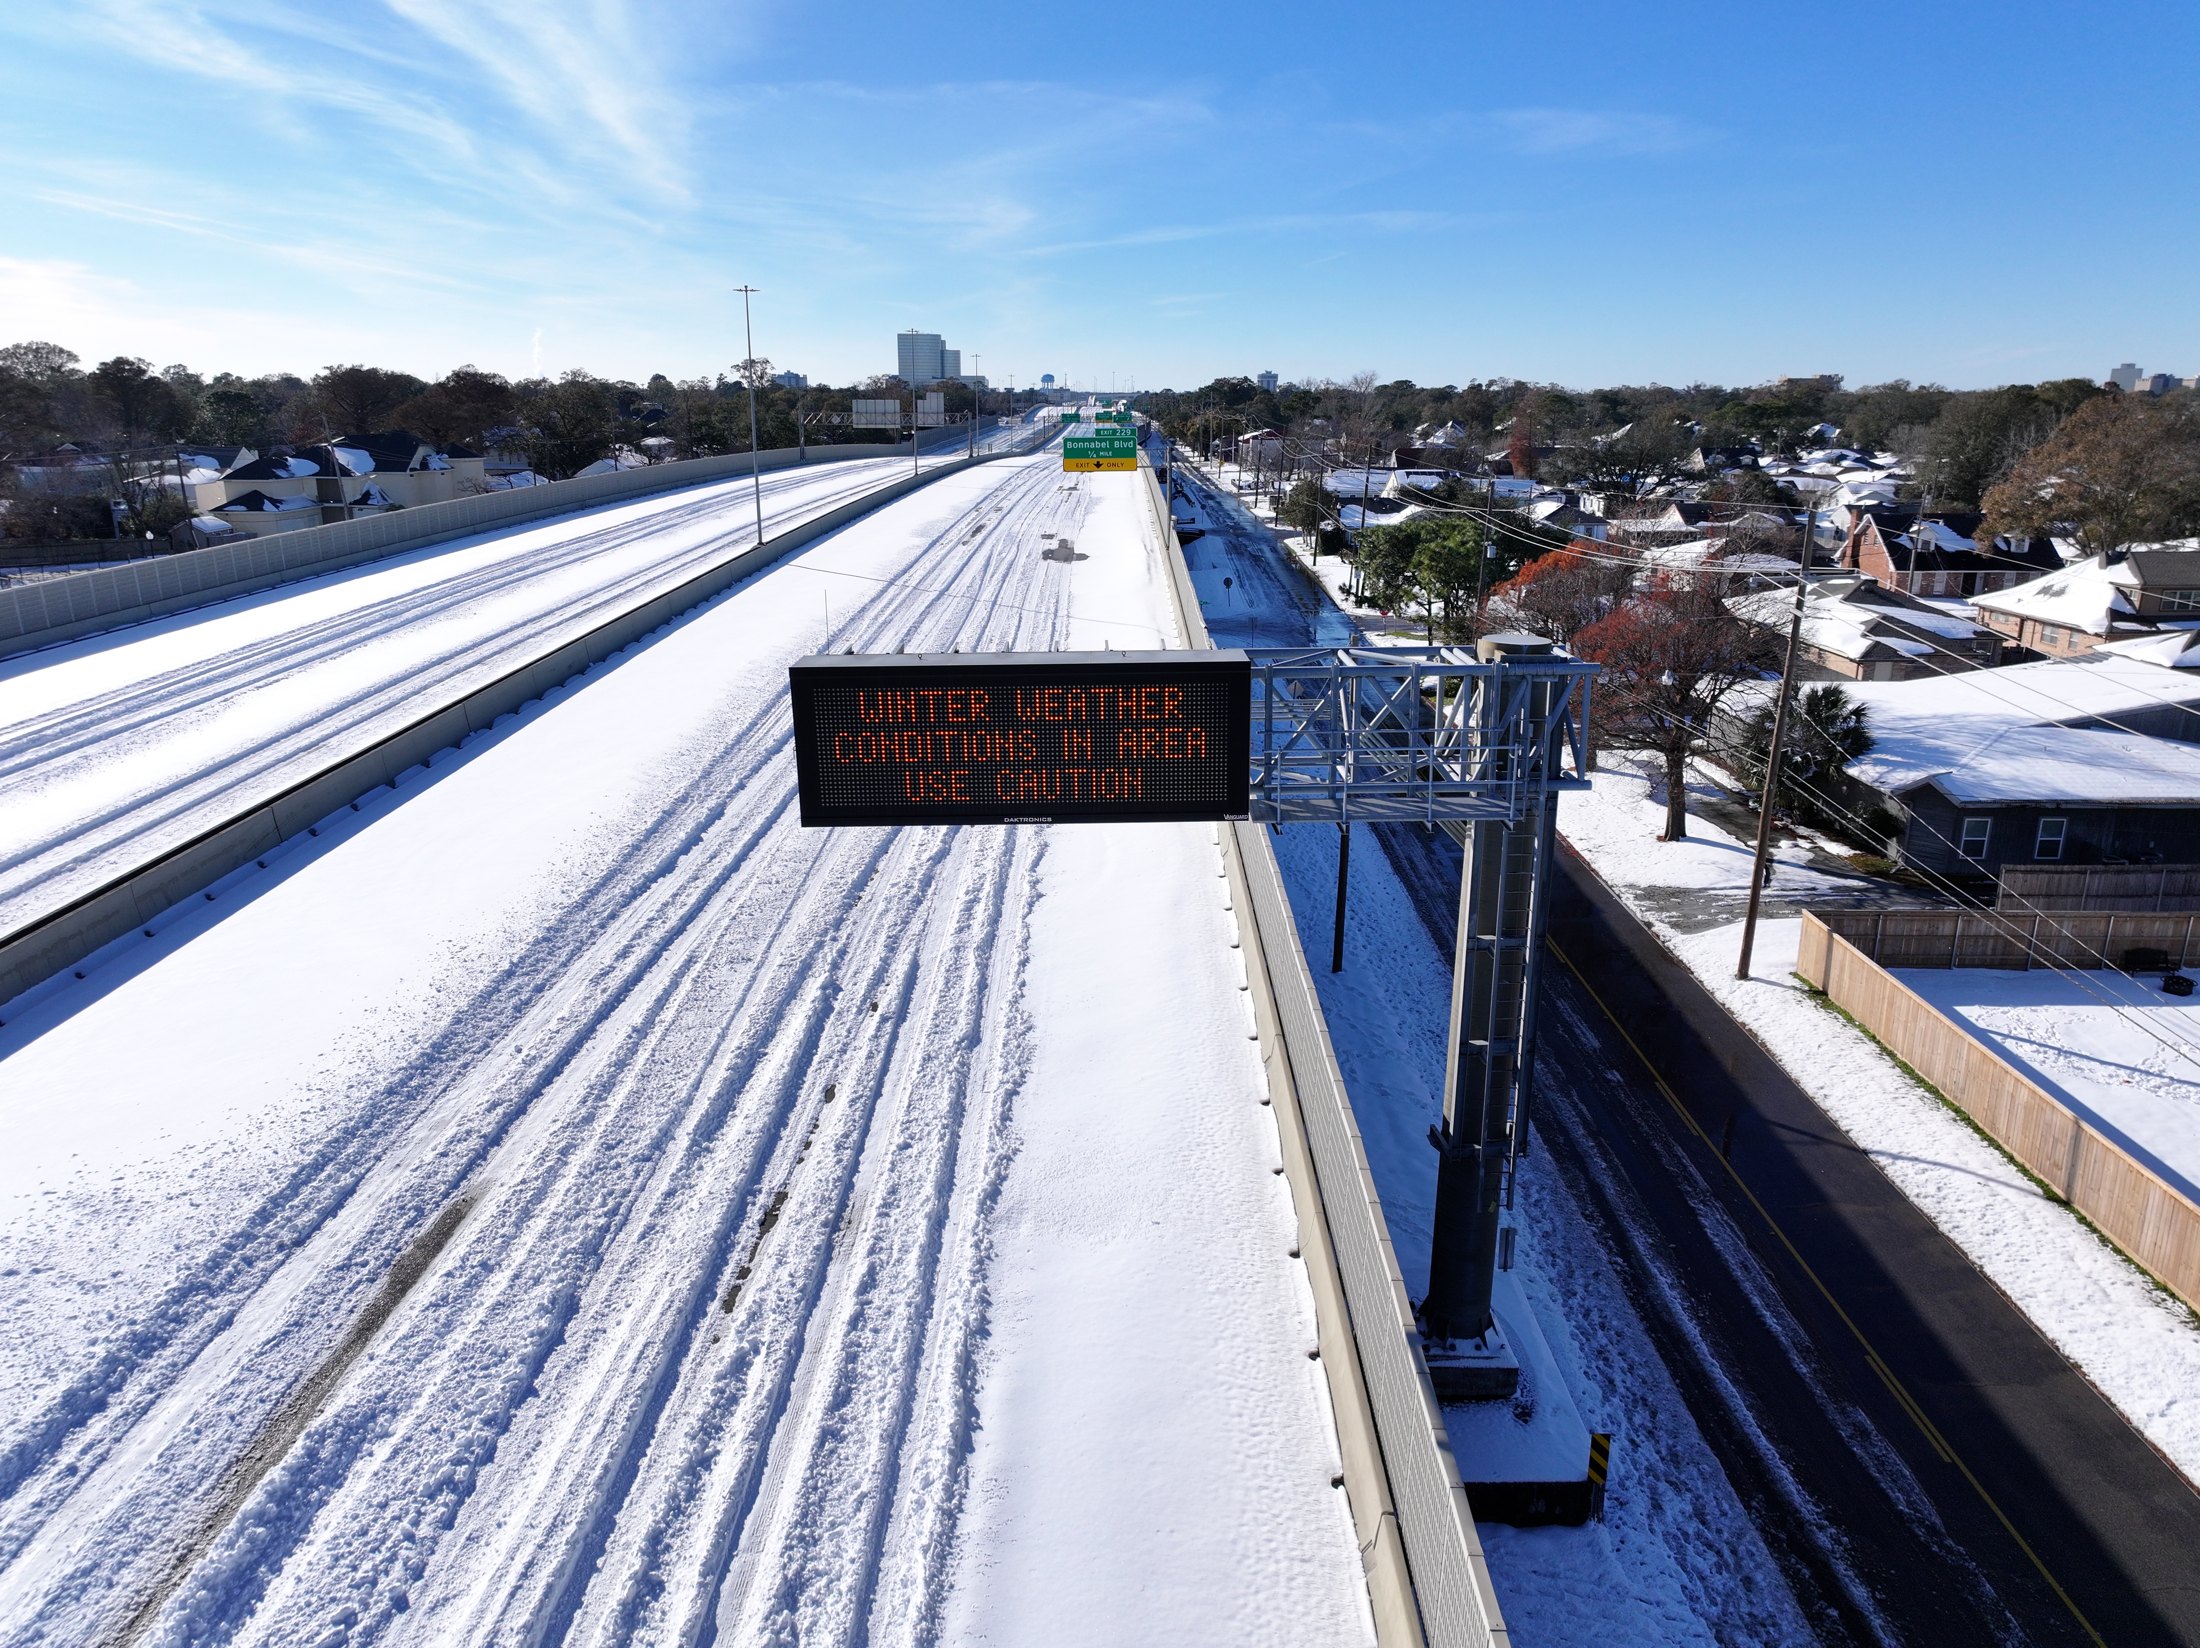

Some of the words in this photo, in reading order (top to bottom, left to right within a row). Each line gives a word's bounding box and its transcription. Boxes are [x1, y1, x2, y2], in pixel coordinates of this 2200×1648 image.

[859, 690, 990, 723] WINTER
[1017, 687, 1183, 721] WEATHER
[834, 730, 1037, 763] CONDITIONS
[1063, 729, 1092, 760] IN
[1119, 728, 1206, 758] AREA
[905, 769, 970, 801] USE
[996, 767, 1142, 800] CAUTION
